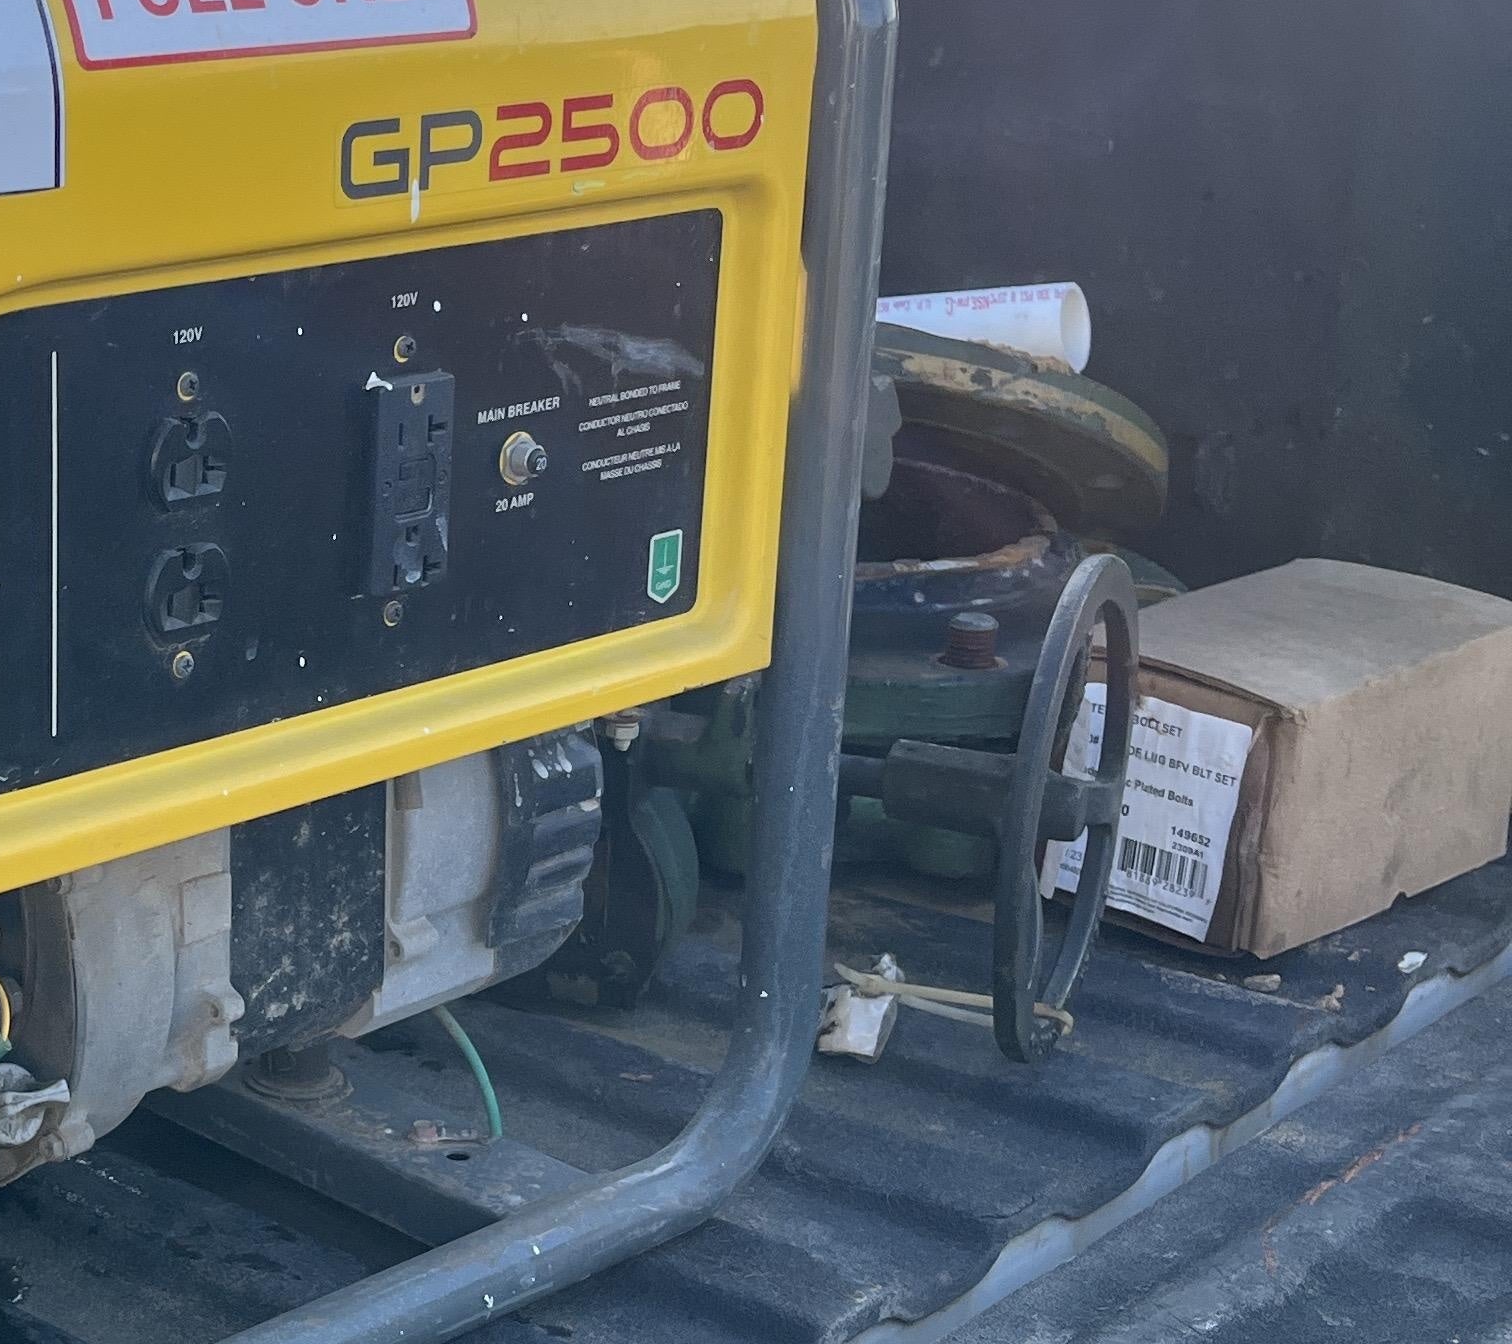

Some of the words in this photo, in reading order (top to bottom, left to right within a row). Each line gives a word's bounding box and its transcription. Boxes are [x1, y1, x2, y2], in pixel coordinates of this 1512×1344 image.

[340, 78, 765, 201] GP2500
[391, 291, 419, 309] 120V
[172, 326, 203, 345] 120V
[477, 407, 506, 425] MAIN
[507, 396, 560, 419] BREAKER
[535, 456, 548, 472] 20
[495, 498, 509, 513] 20
[509, 492, 535, 510] AMP
[1162, 719, 1184, 738] SET
[1192, 764, 1214, 782] BLT
[1214, 771, 1237, 788] SET
[1167, 789, 1194, 808] Bolts
